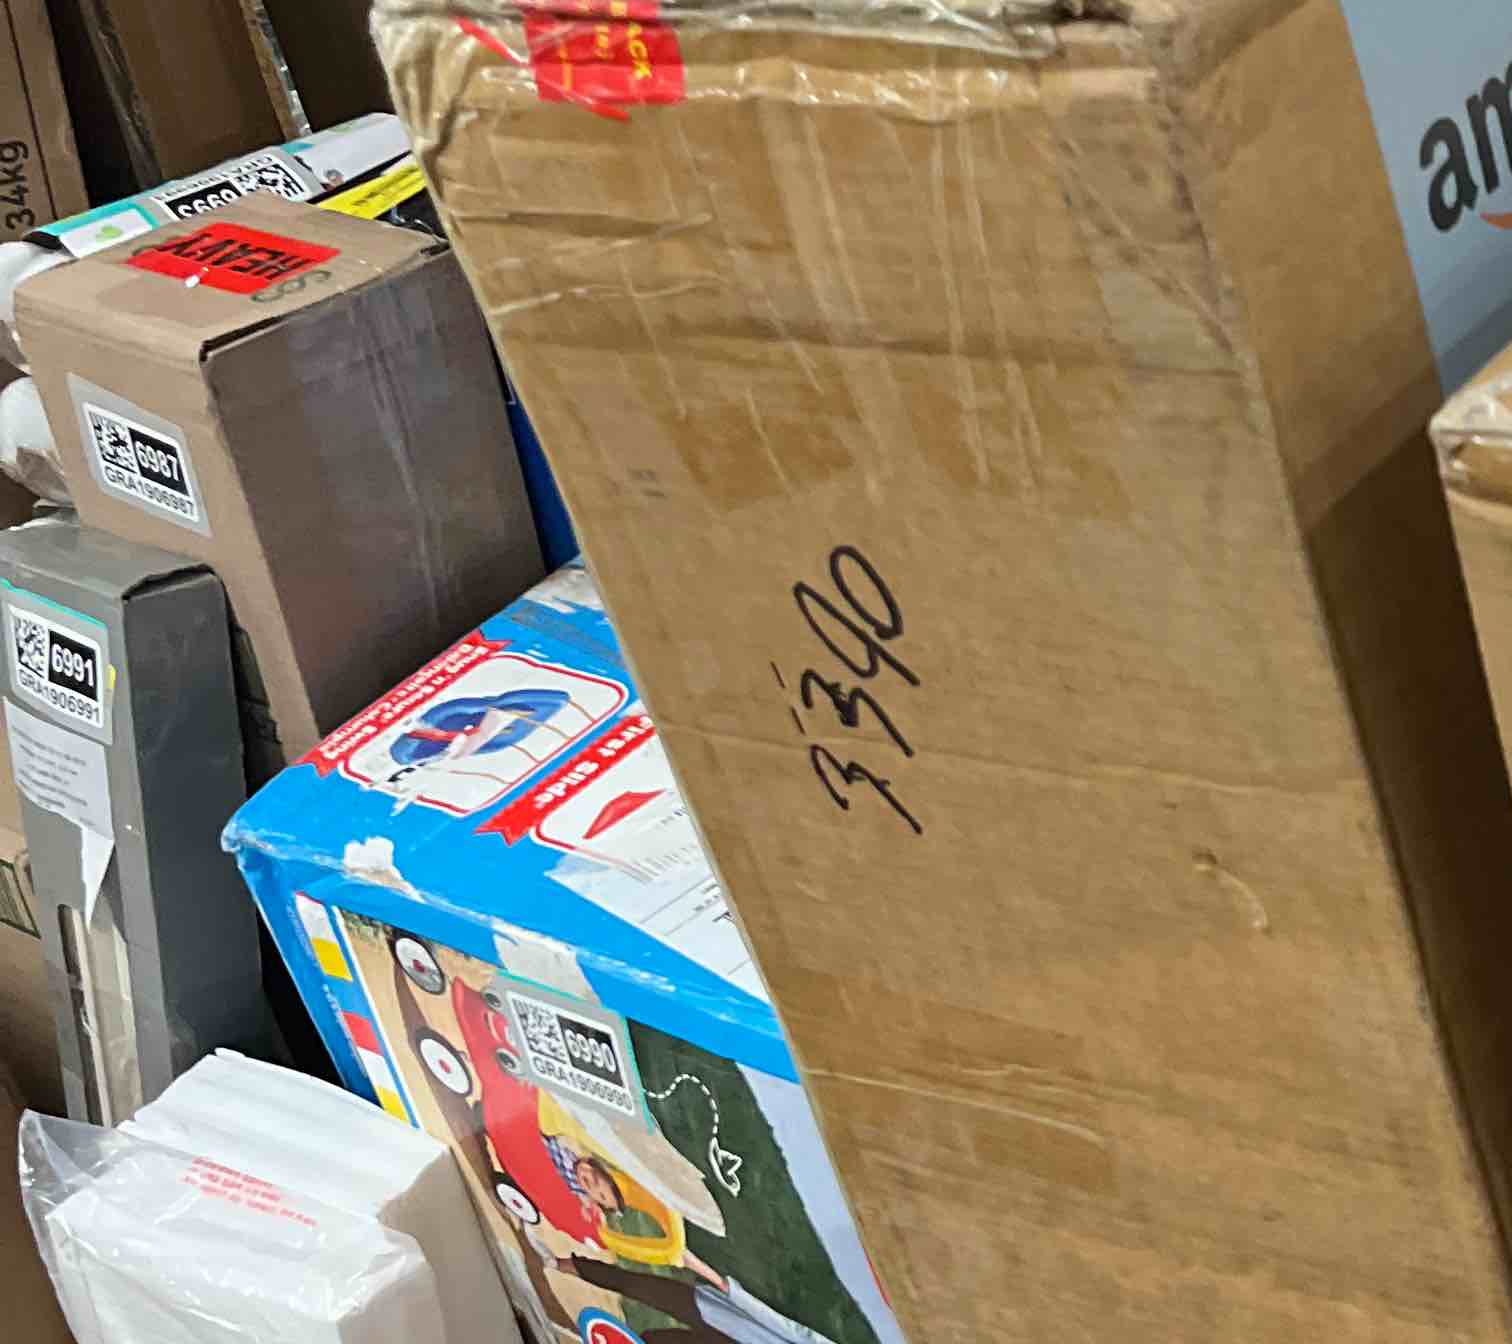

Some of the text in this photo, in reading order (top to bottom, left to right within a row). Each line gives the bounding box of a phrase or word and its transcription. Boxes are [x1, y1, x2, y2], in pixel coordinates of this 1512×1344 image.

[135, 440, 181, 481] 6987
[52, 643, 95, 688] 6991
[18, 667, 101, 724] GRA1906991
[564, 1028, 618, 1074] 6990
